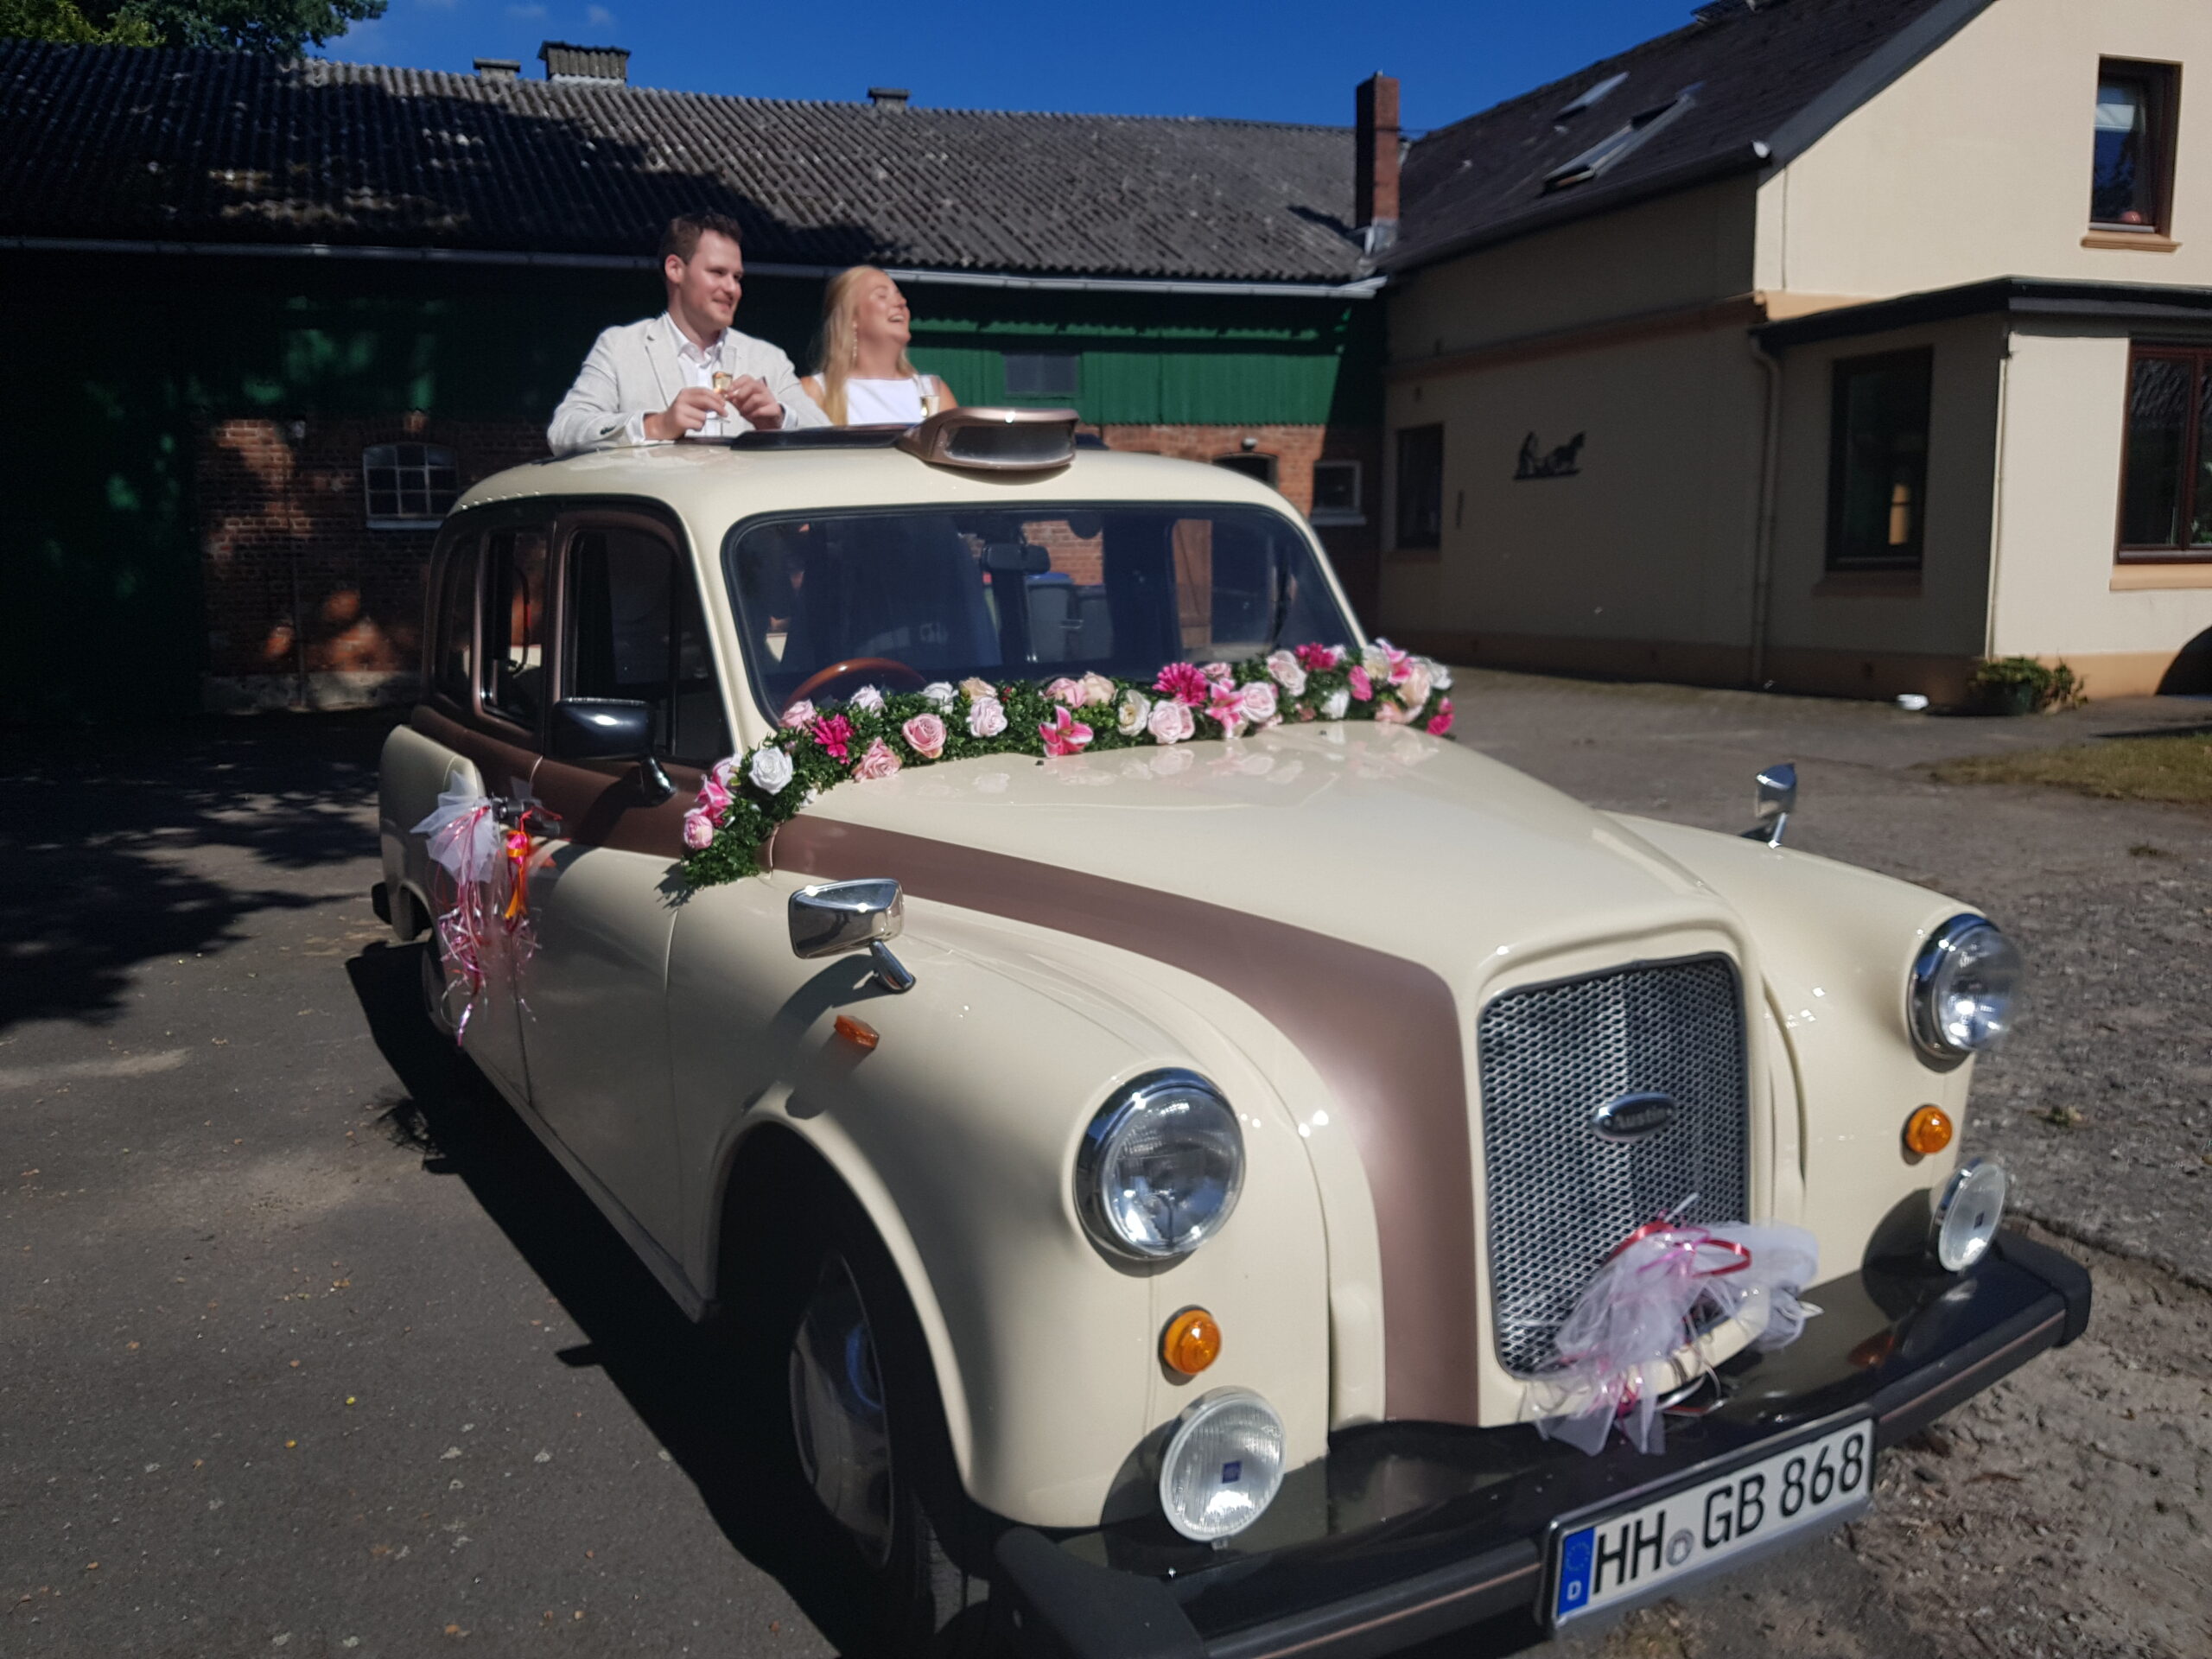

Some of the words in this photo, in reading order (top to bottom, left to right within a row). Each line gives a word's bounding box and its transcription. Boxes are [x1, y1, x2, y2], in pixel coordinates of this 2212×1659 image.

[1594, 1511, 1666, 1593] HH
[1703, 1474, 1765, 1548] GB
[1780, 1433, 1864, 1517] 868
[1567, 1580, 1581, 1601] D
